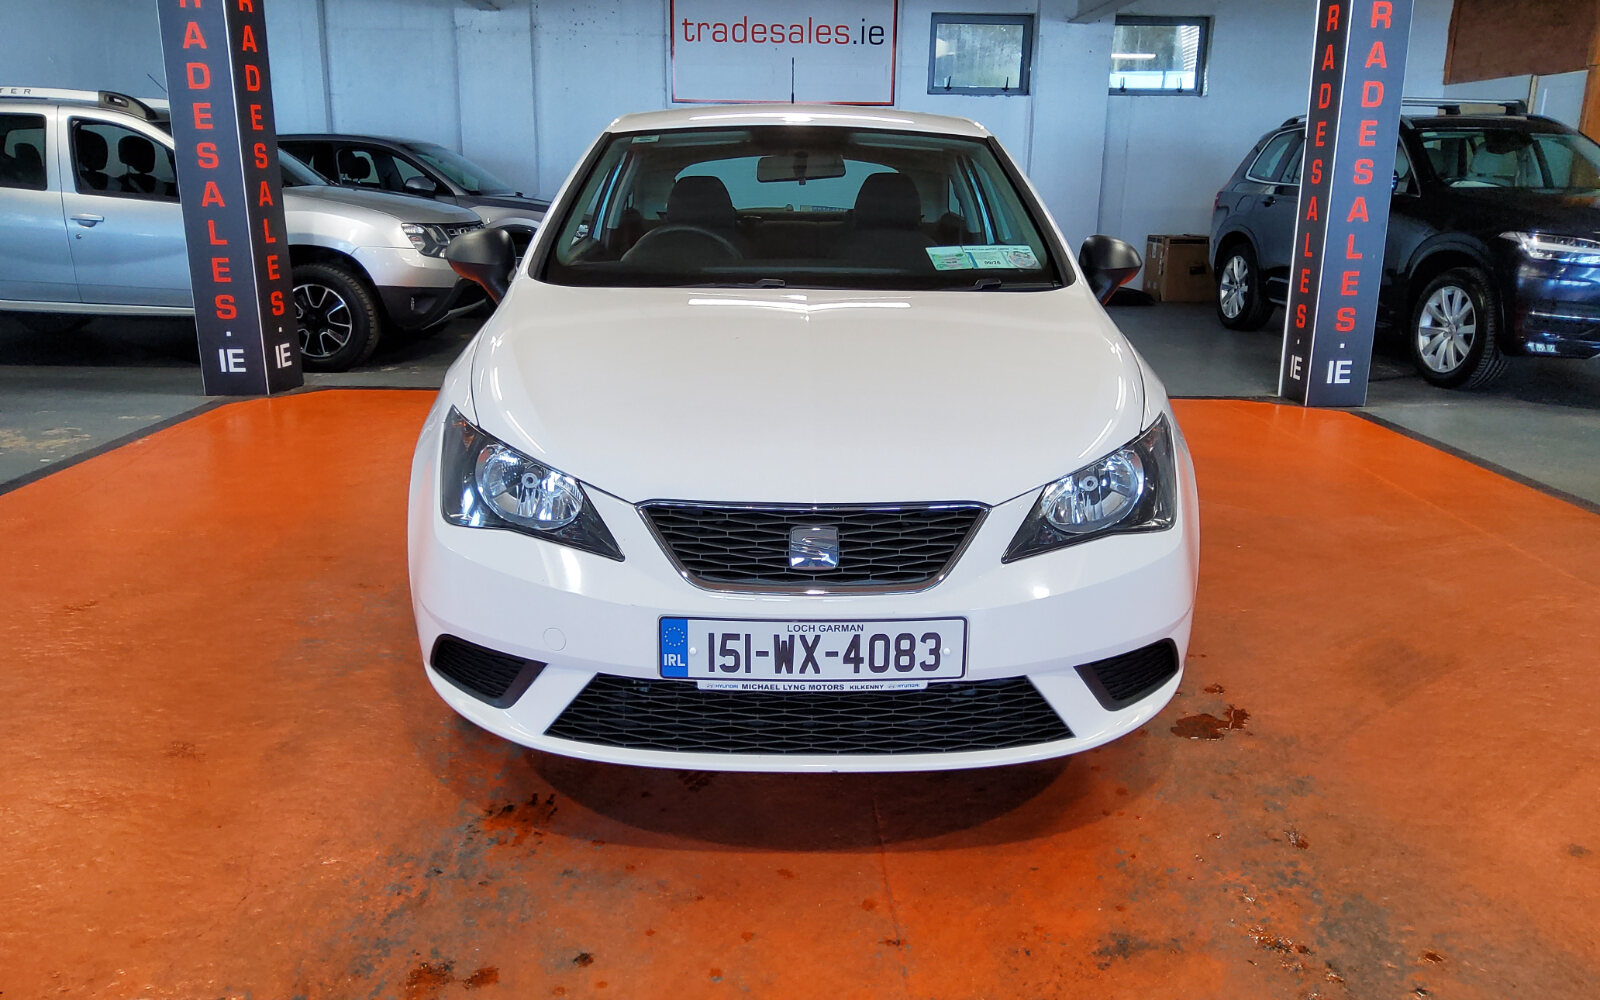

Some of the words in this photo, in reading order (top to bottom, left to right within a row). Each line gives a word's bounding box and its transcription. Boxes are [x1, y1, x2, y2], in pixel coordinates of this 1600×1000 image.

[682, 16, 885, 45] tradesales.ie
[787, 624, 816, 633] LOCH
[818, 624, 864, 633] GARMAN
[663, 653, 686, 667] IRL
[708, 632, 942, 674] 151-WX-4083
